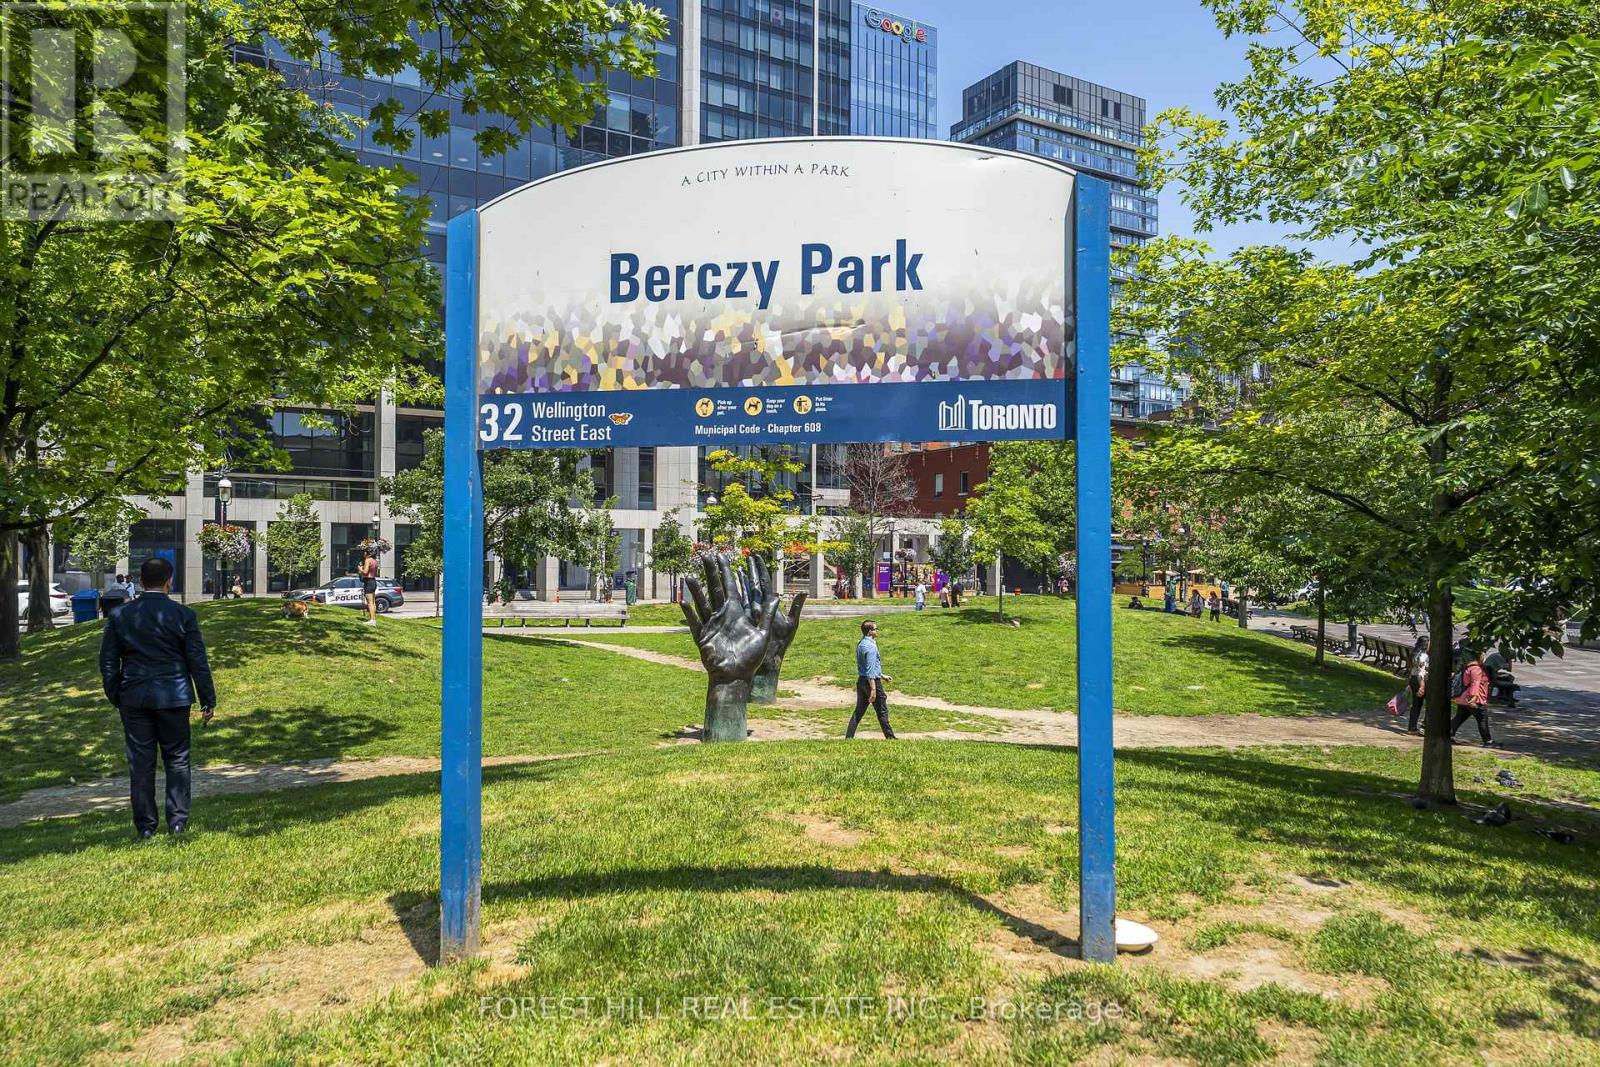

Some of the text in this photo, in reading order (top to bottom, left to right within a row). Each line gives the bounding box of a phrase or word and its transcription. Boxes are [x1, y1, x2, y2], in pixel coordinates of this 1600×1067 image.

[866, 8, 927, 43] Google
[681, 163, 849, 186] A CITY WITHIN A PARK
[610, 239, 924, 310] Berczy Park
[479, 402, 523, 442] 32
[532, 401, 606, 421] Wellington
[968, 399, 1057, 430] TORONTO
[532, 424, 612, 441] Street East
[695, 424, 737, 436] Municipal
[739, 424, 760, 433] Code
[768, 423, 802, 435] Chapter
[804, 422, 821, 432] 608
